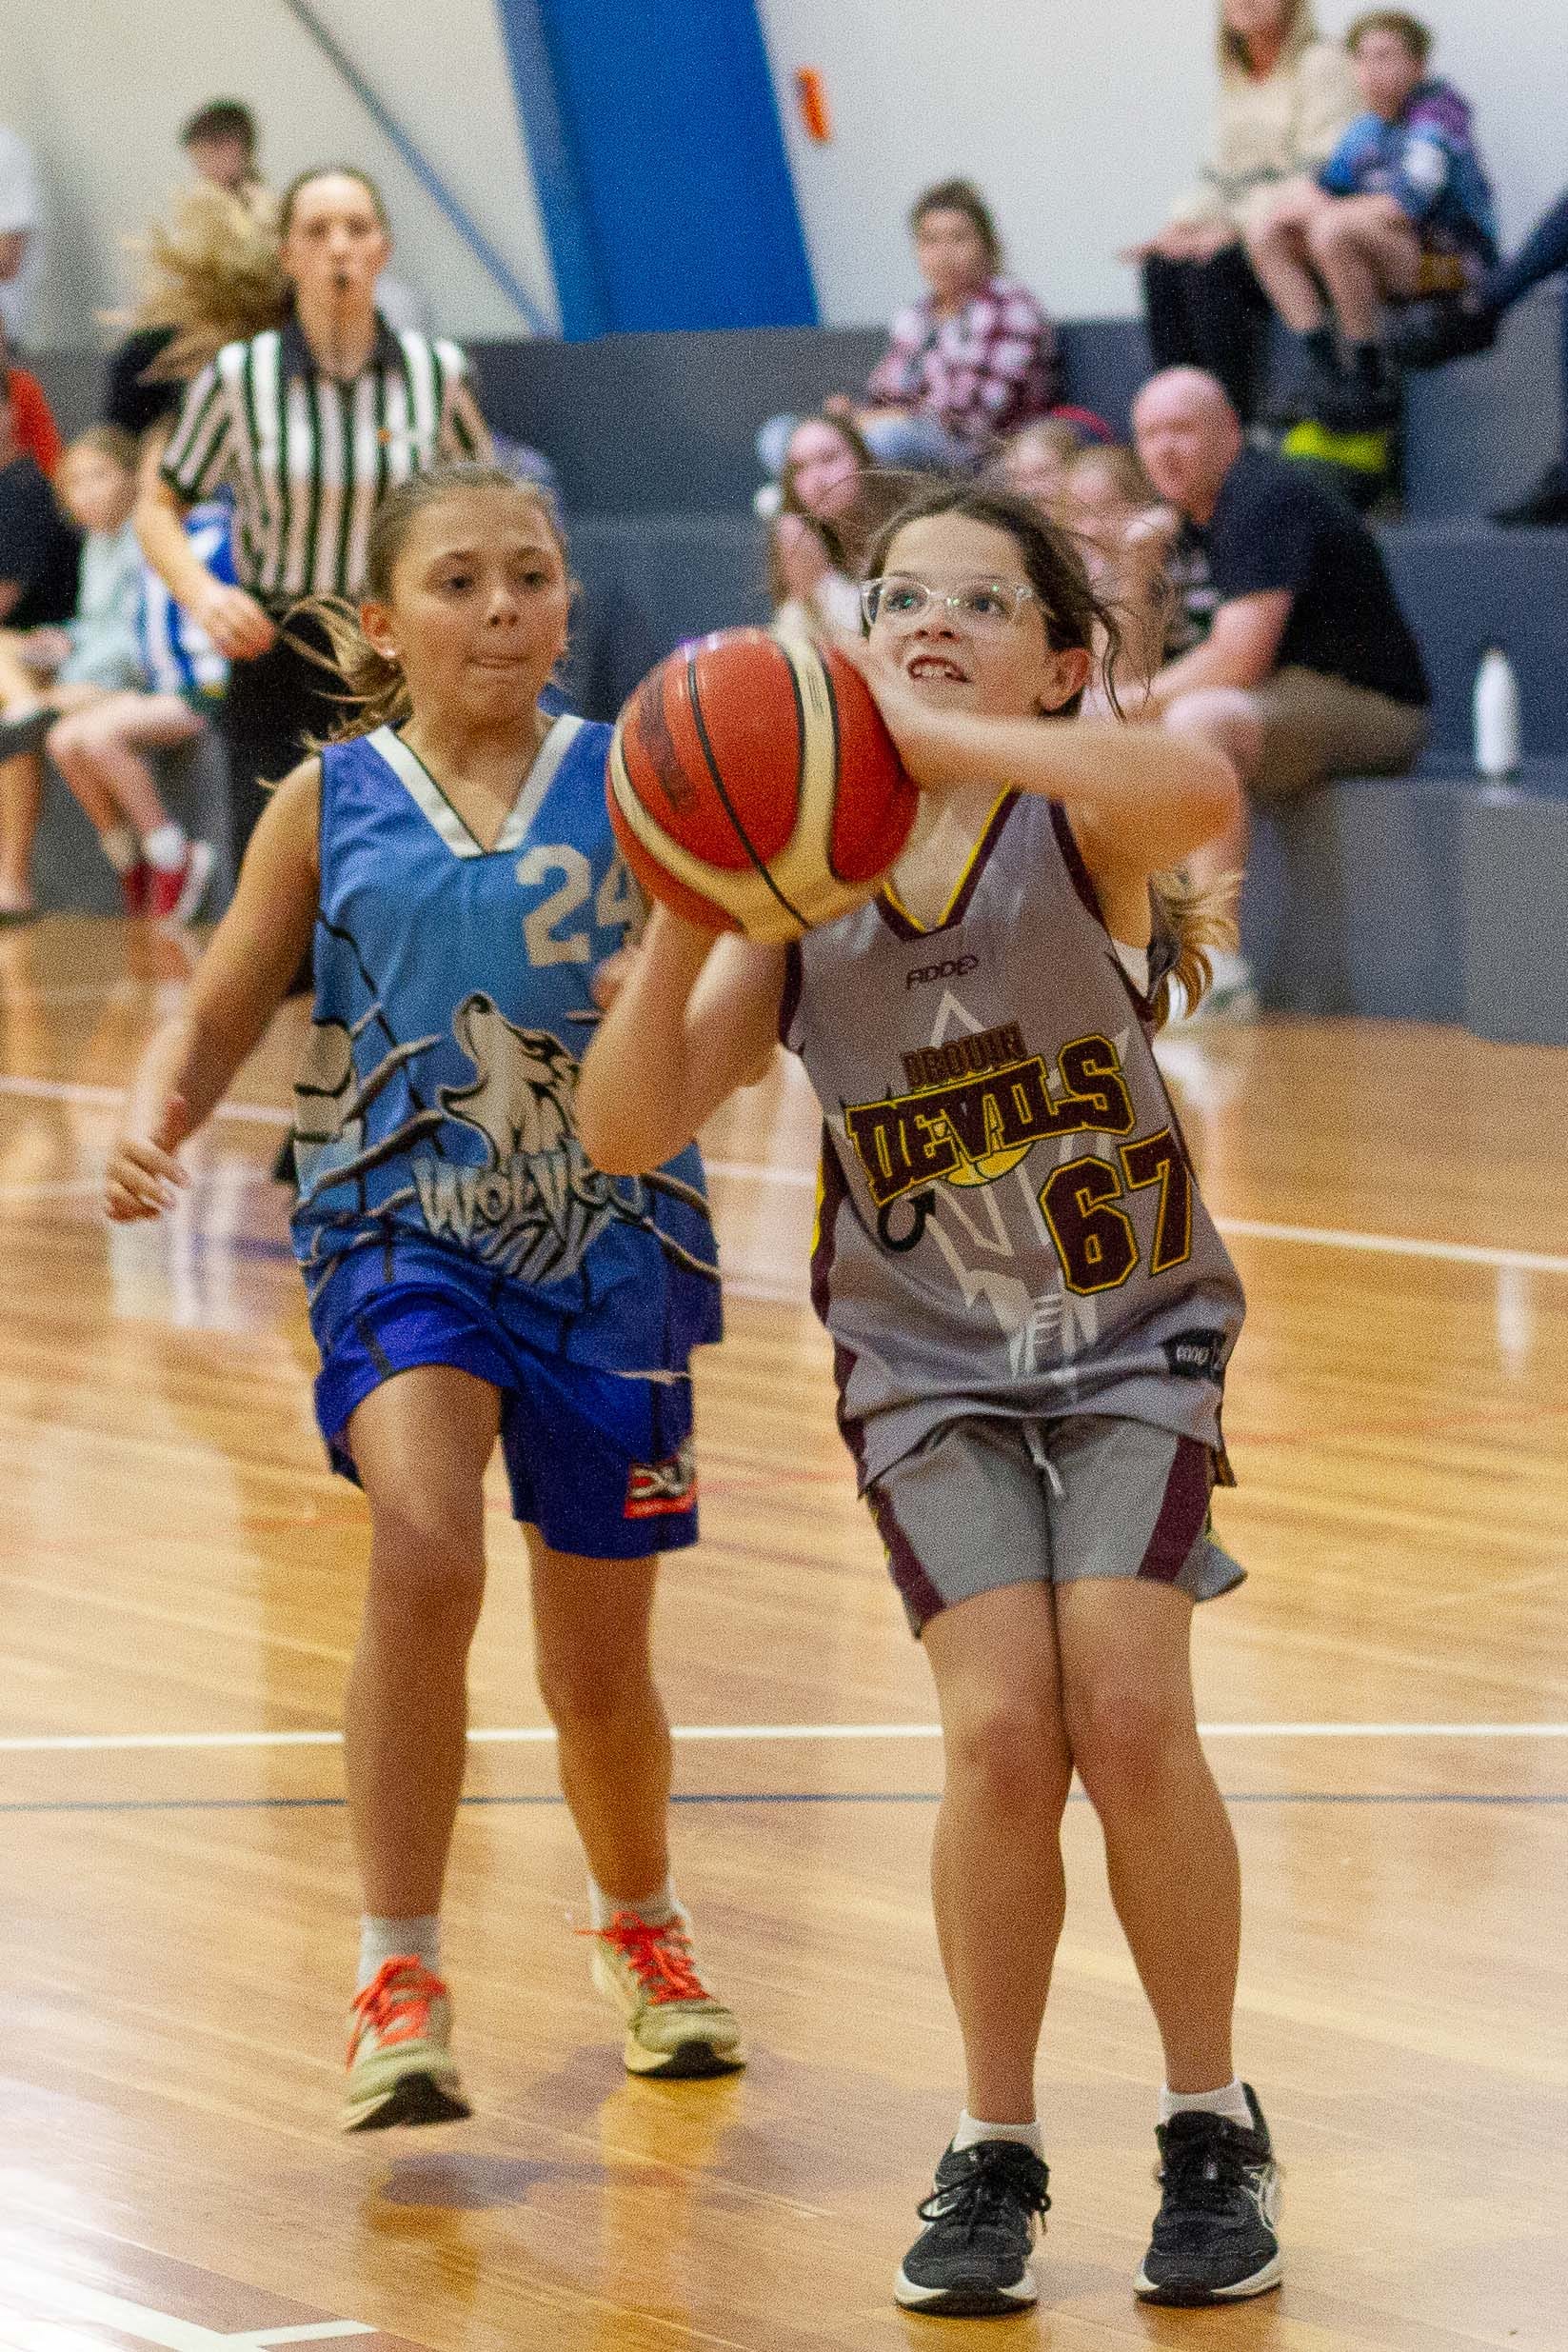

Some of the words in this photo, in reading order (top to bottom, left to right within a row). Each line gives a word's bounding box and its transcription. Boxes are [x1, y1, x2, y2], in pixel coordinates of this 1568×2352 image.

[515, 844, 651, 967] 24
[845, 1033, 1136, 1206] DEVILS
[1039, 1127, 1192, 1296] 67
